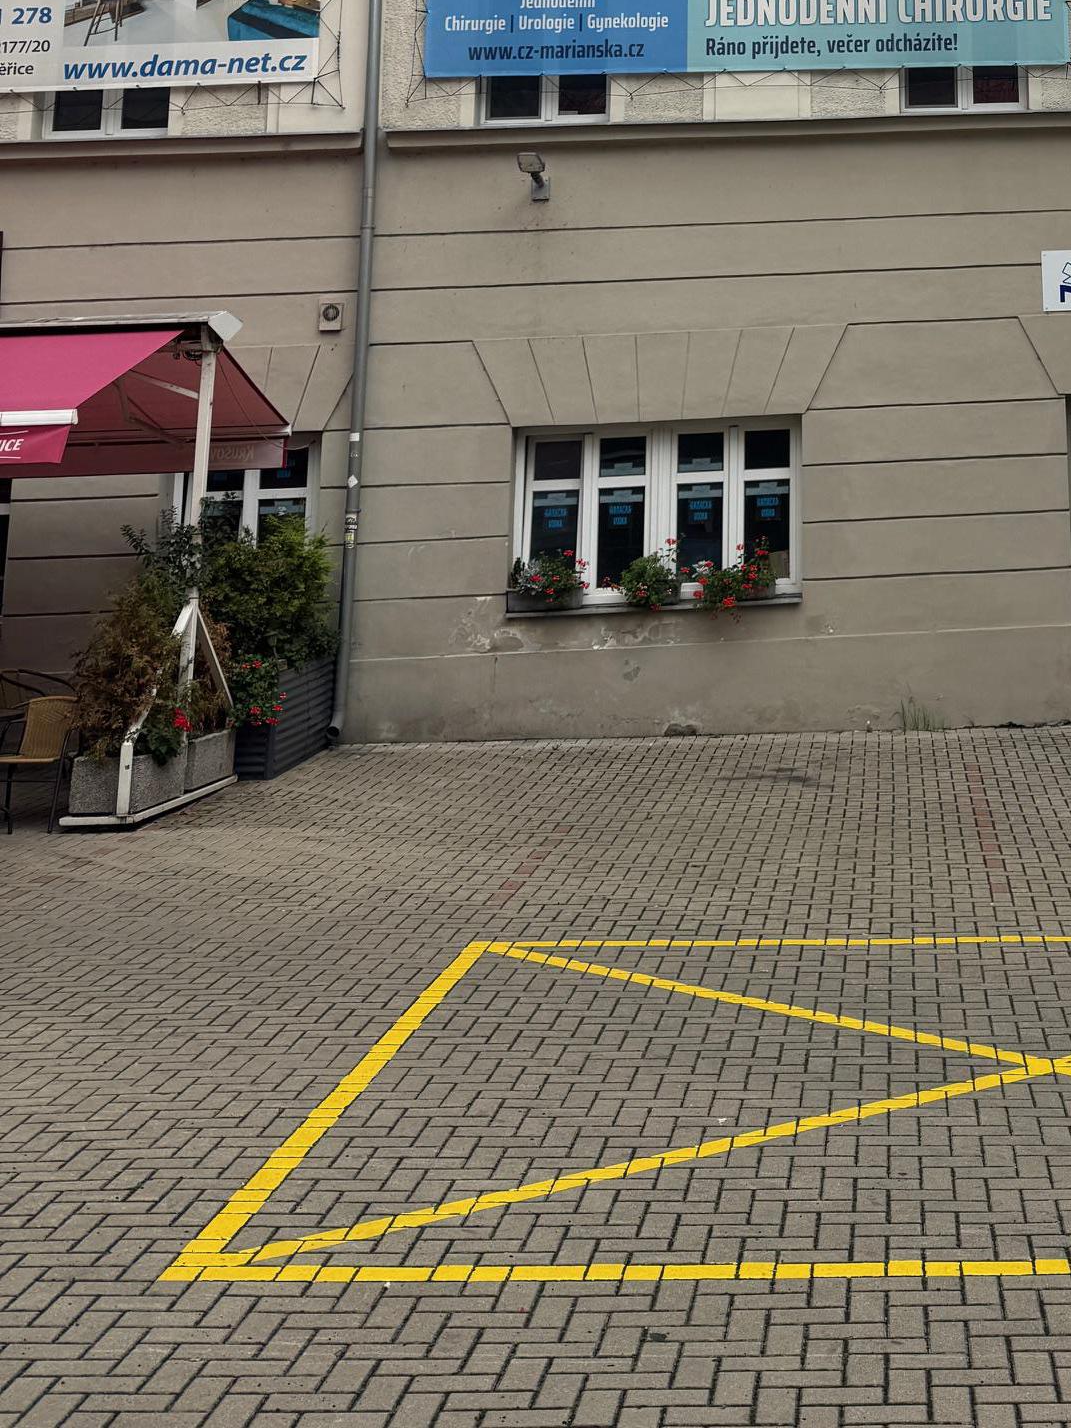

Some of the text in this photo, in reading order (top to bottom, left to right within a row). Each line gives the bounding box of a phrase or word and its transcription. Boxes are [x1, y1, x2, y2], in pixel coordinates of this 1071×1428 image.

[11, 6, 52, 25] 278
[444, 13, 669, 34] Chirurgie Urologie Gynekologie
[0, 40, 51, 53] 177/20
[468, 39, 644, 60] www.cz-marianska.cz
[705, 32, 958, 59] Ráno přijdete, večer odcházíte!
[64, 52, 306, 80] www.dama-net.cz
[0, 439, 24, 451] ICE
